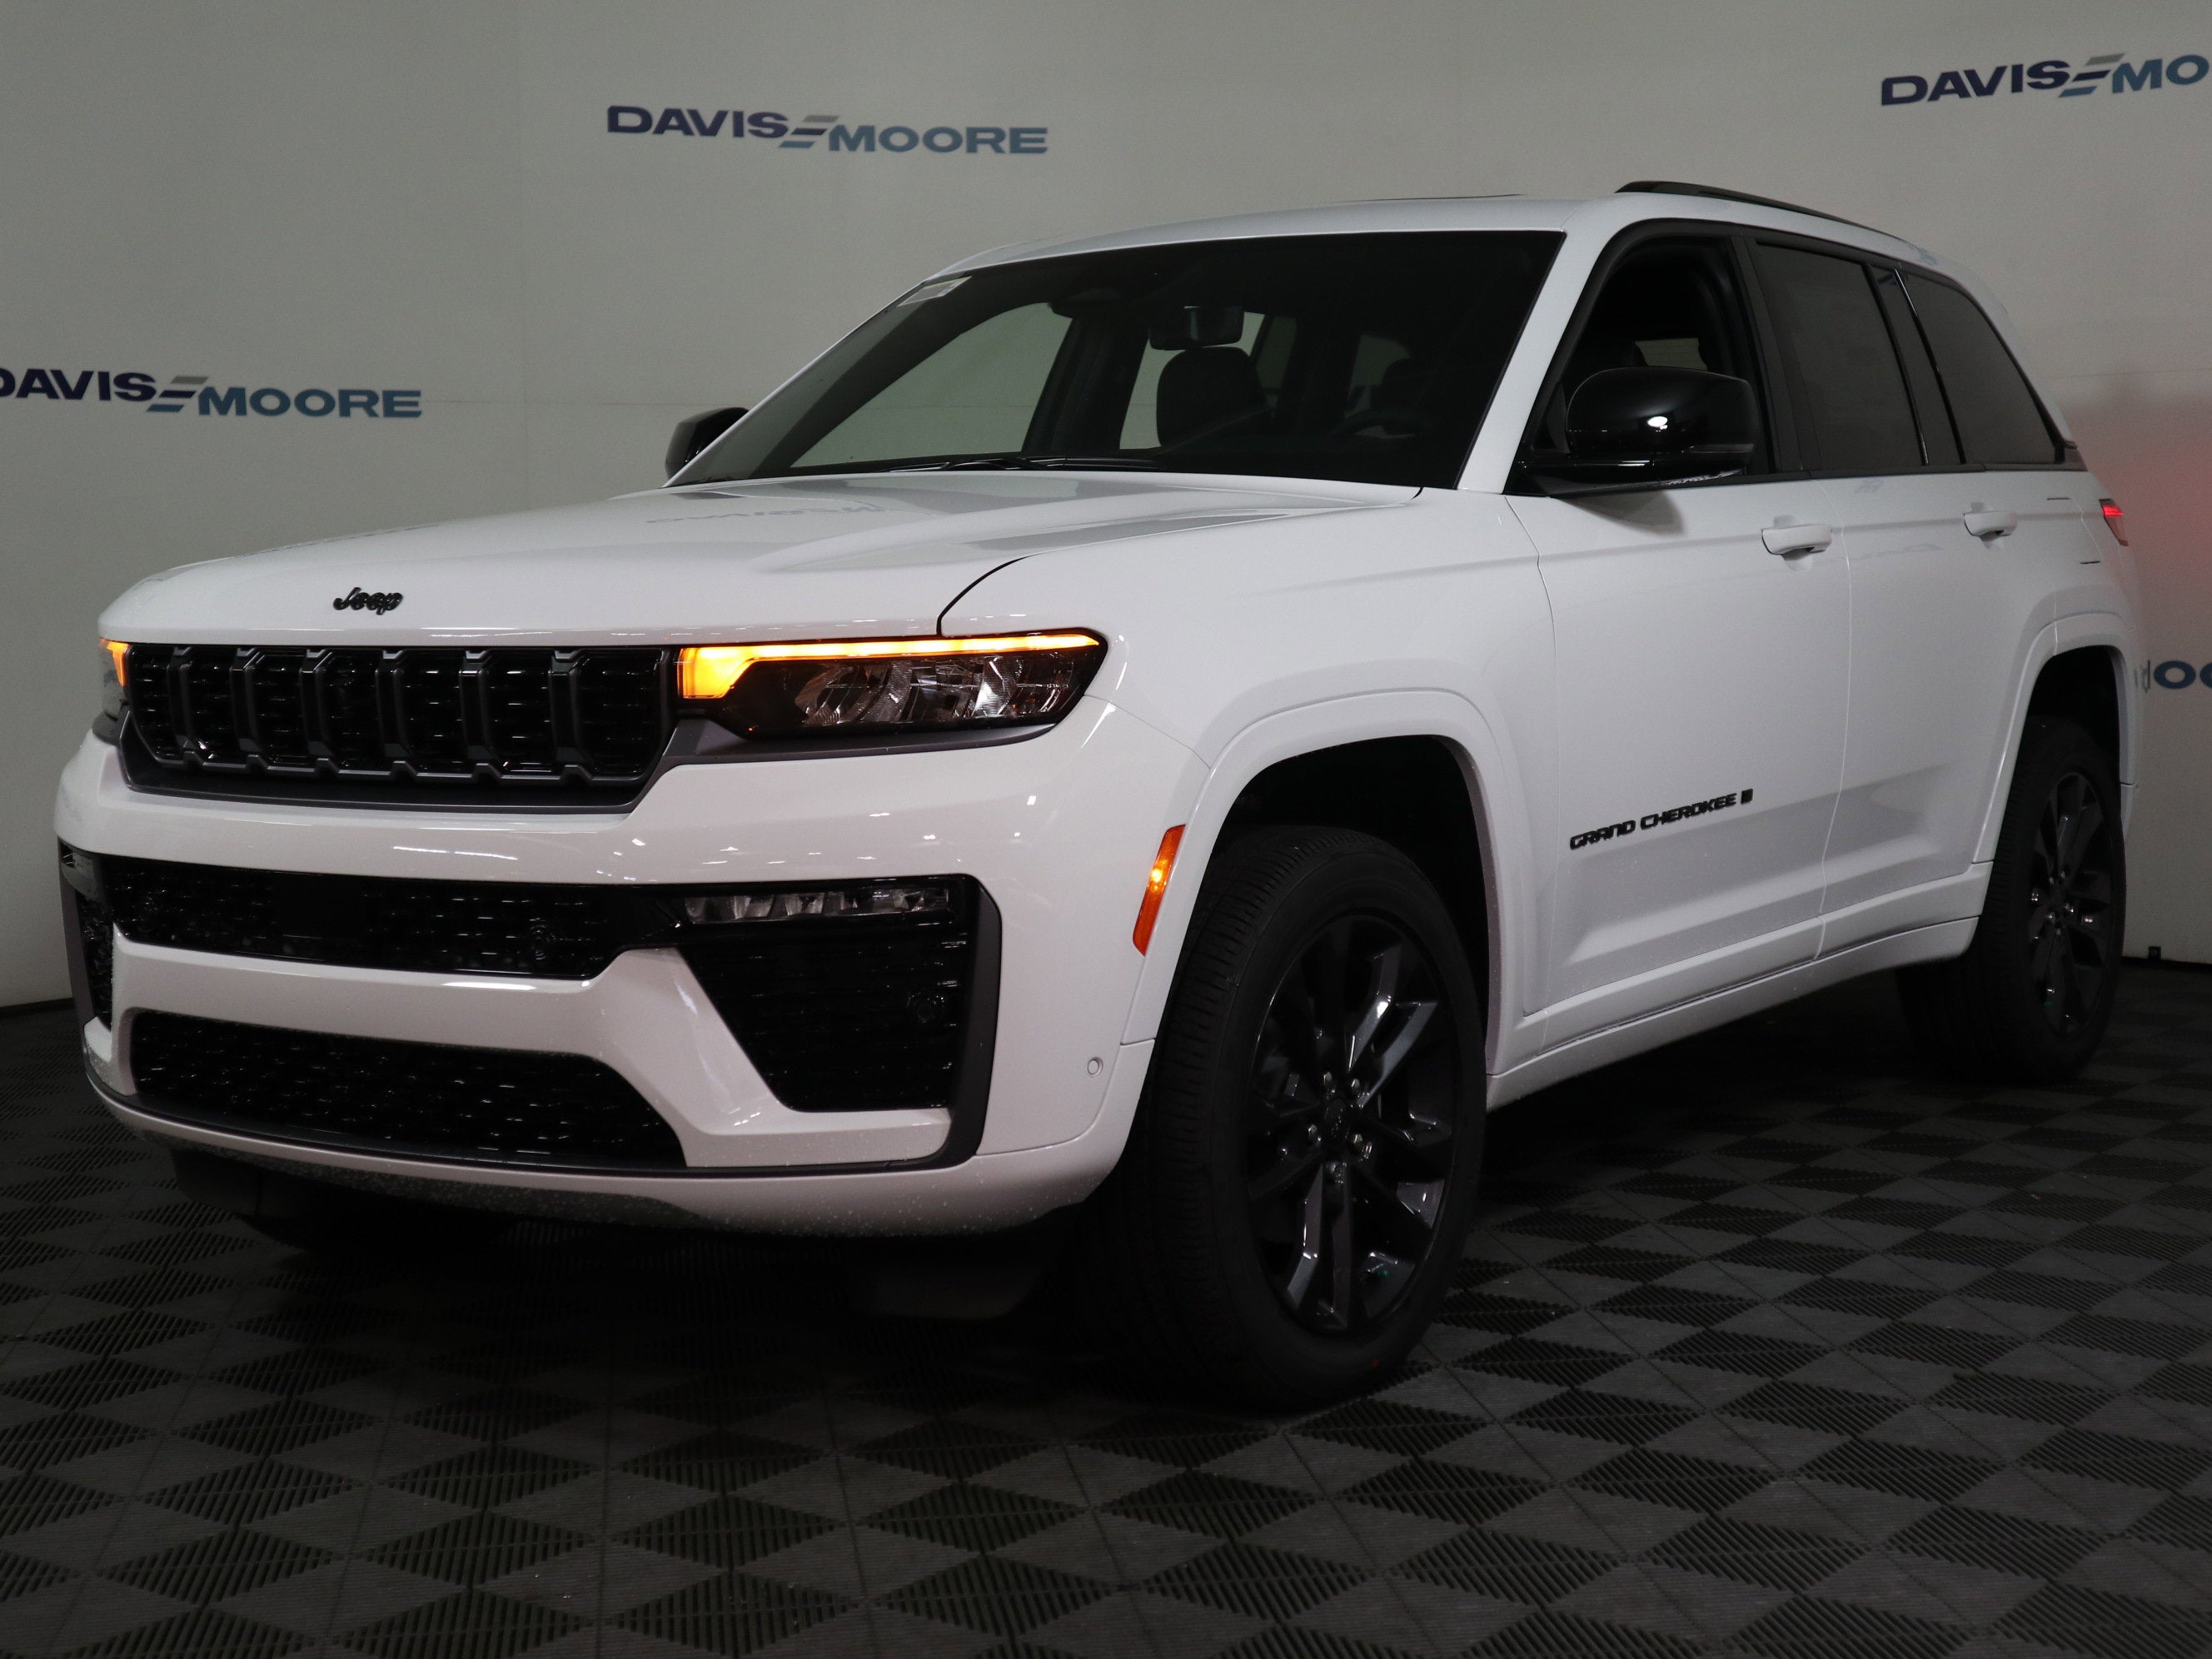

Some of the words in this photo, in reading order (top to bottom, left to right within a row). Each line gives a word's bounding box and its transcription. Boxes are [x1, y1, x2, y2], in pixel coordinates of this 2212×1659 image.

[1881, 60, 2070, 106] DAVIS
[607, 106, 787, 138] DAVIS
[829, 125, 1048, 154] MOORE
[198, 386, 421, 417] MOORE
[333, 586, 403, 615] Jeep
[1570, 820, 1636, 849] GRAND
[1641, 793, 1736, 830] CHEROKEE
